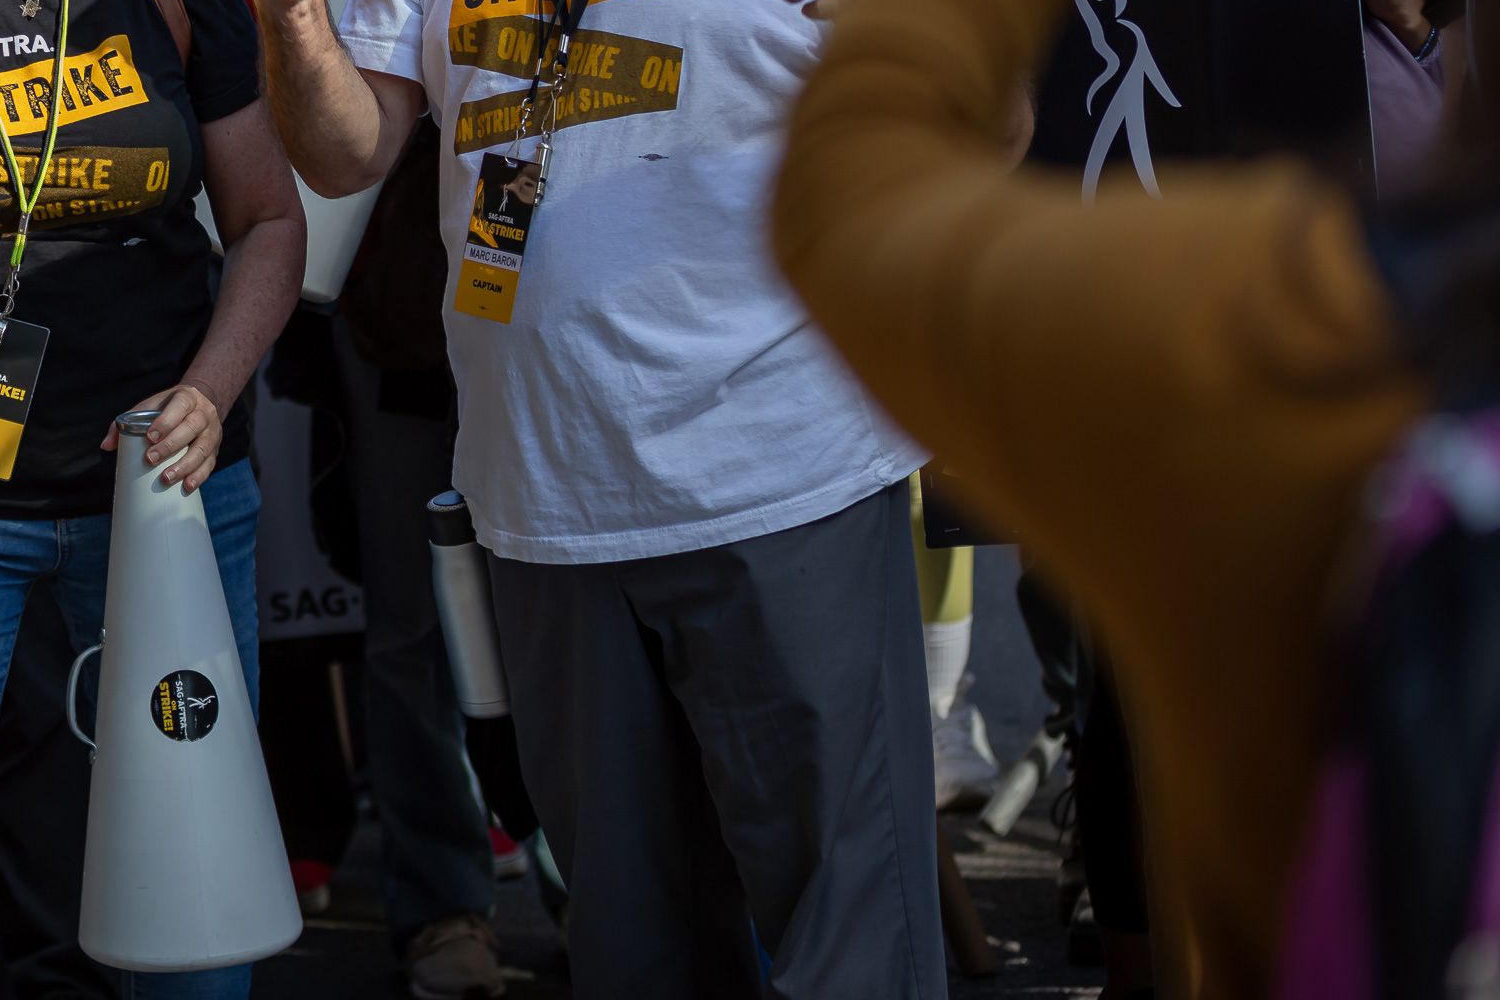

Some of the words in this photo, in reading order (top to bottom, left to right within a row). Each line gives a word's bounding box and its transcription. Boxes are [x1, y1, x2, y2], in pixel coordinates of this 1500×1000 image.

[497, 26, 536, 66] ON
[640, 56, 682, 95] ON
[32, 199, 66, 222] ON
[489, 222, 526, 242] STRIKE!
[469, 247, 491, 262] MARC
[491, 253, 517, 269] BARON
[472, 278, 503, 294] CAPTAIN
[159, 681, 174, 732] STRIKE!
[171, 700, 177, 711] ON
